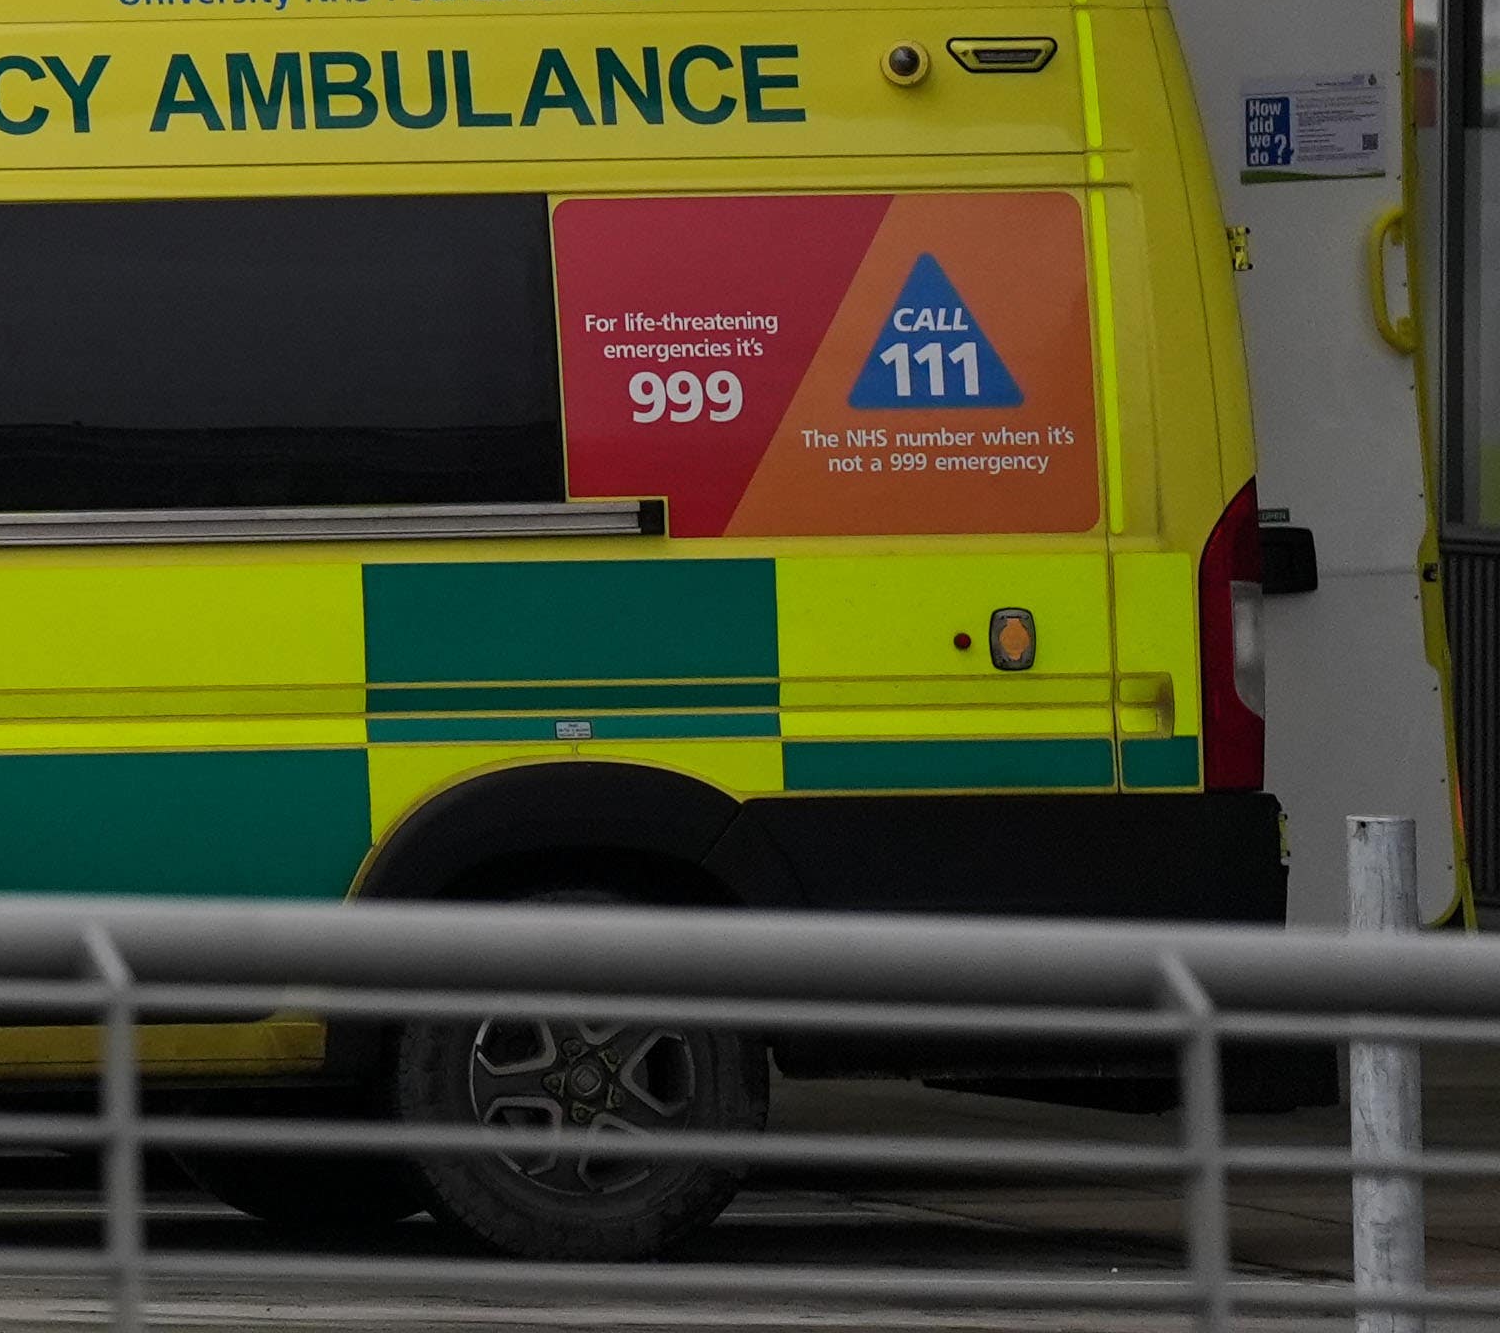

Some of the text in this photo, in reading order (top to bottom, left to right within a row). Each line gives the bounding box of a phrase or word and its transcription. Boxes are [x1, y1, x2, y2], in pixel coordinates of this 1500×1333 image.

[150, 45, 806, 131] AMBULANCE
[1249, 100, 1282, 116] How
[1249, 117, 1275, 133] did
[1250, 149, 1270, 164] do
[586, 311, 778, 334] For life-threatening
[894, 308, 968, 332] CALL
[604, 338, 763, 362] emergencies it's
[880, 342, 979, 396] 111
[629, 371, 742, 423] 999
[801, 426, 1074, 447] The NHS number when it's
[829, 453, 1048, 474] not a 999 emergency
